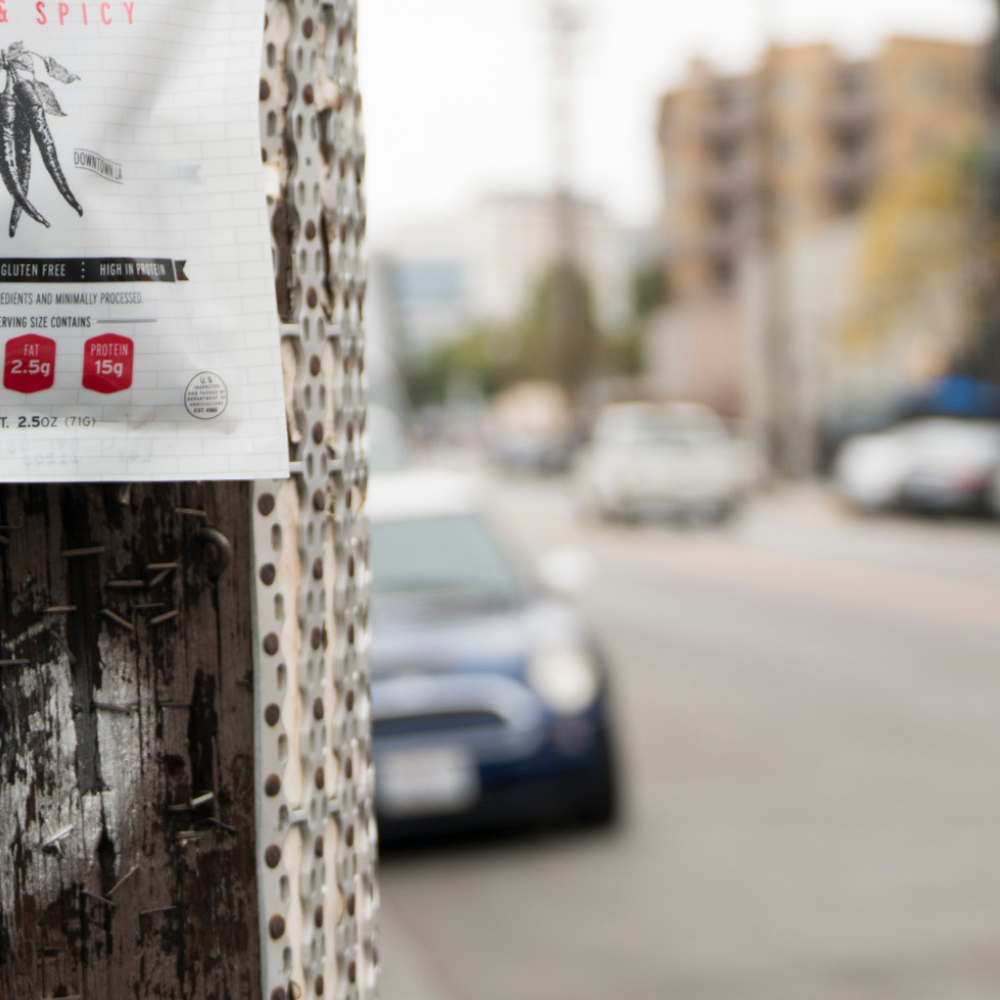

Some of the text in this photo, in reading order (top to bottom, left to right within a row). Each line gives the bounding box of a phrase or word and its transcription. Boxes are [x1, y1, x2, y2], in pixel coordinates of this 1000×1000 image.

[35, 1, 135, 26] SPICY
[74, 151, 123, 180] DOWNTOWN LA
[1, 263, 38, 277] GLUTEN
[42, 263, 66, 277] FREE
[100, 263, 122, 276] HIGH
[125, 263, 133, 276] IN
[136, 263, 165, 276] PROTEIN
[36, 292, 52, 305] AND
[55, 292, 98, 305] MINIMALLY
[100, 291, 143, 304] PROCESSED.
[30, 316, 48, 328] SIZE
[50, 316, 91, 328] CONTAINS
[24, 343, 40, 357] FAT
[90, 343, 129, 357] PROTEIN
[10, 360, 50, 377] 2.5g
[95, 360, 124, 378] 15g
[17, 416, 58, 429] 2.5OZ
[64, 416, 96, 428] (71G)
